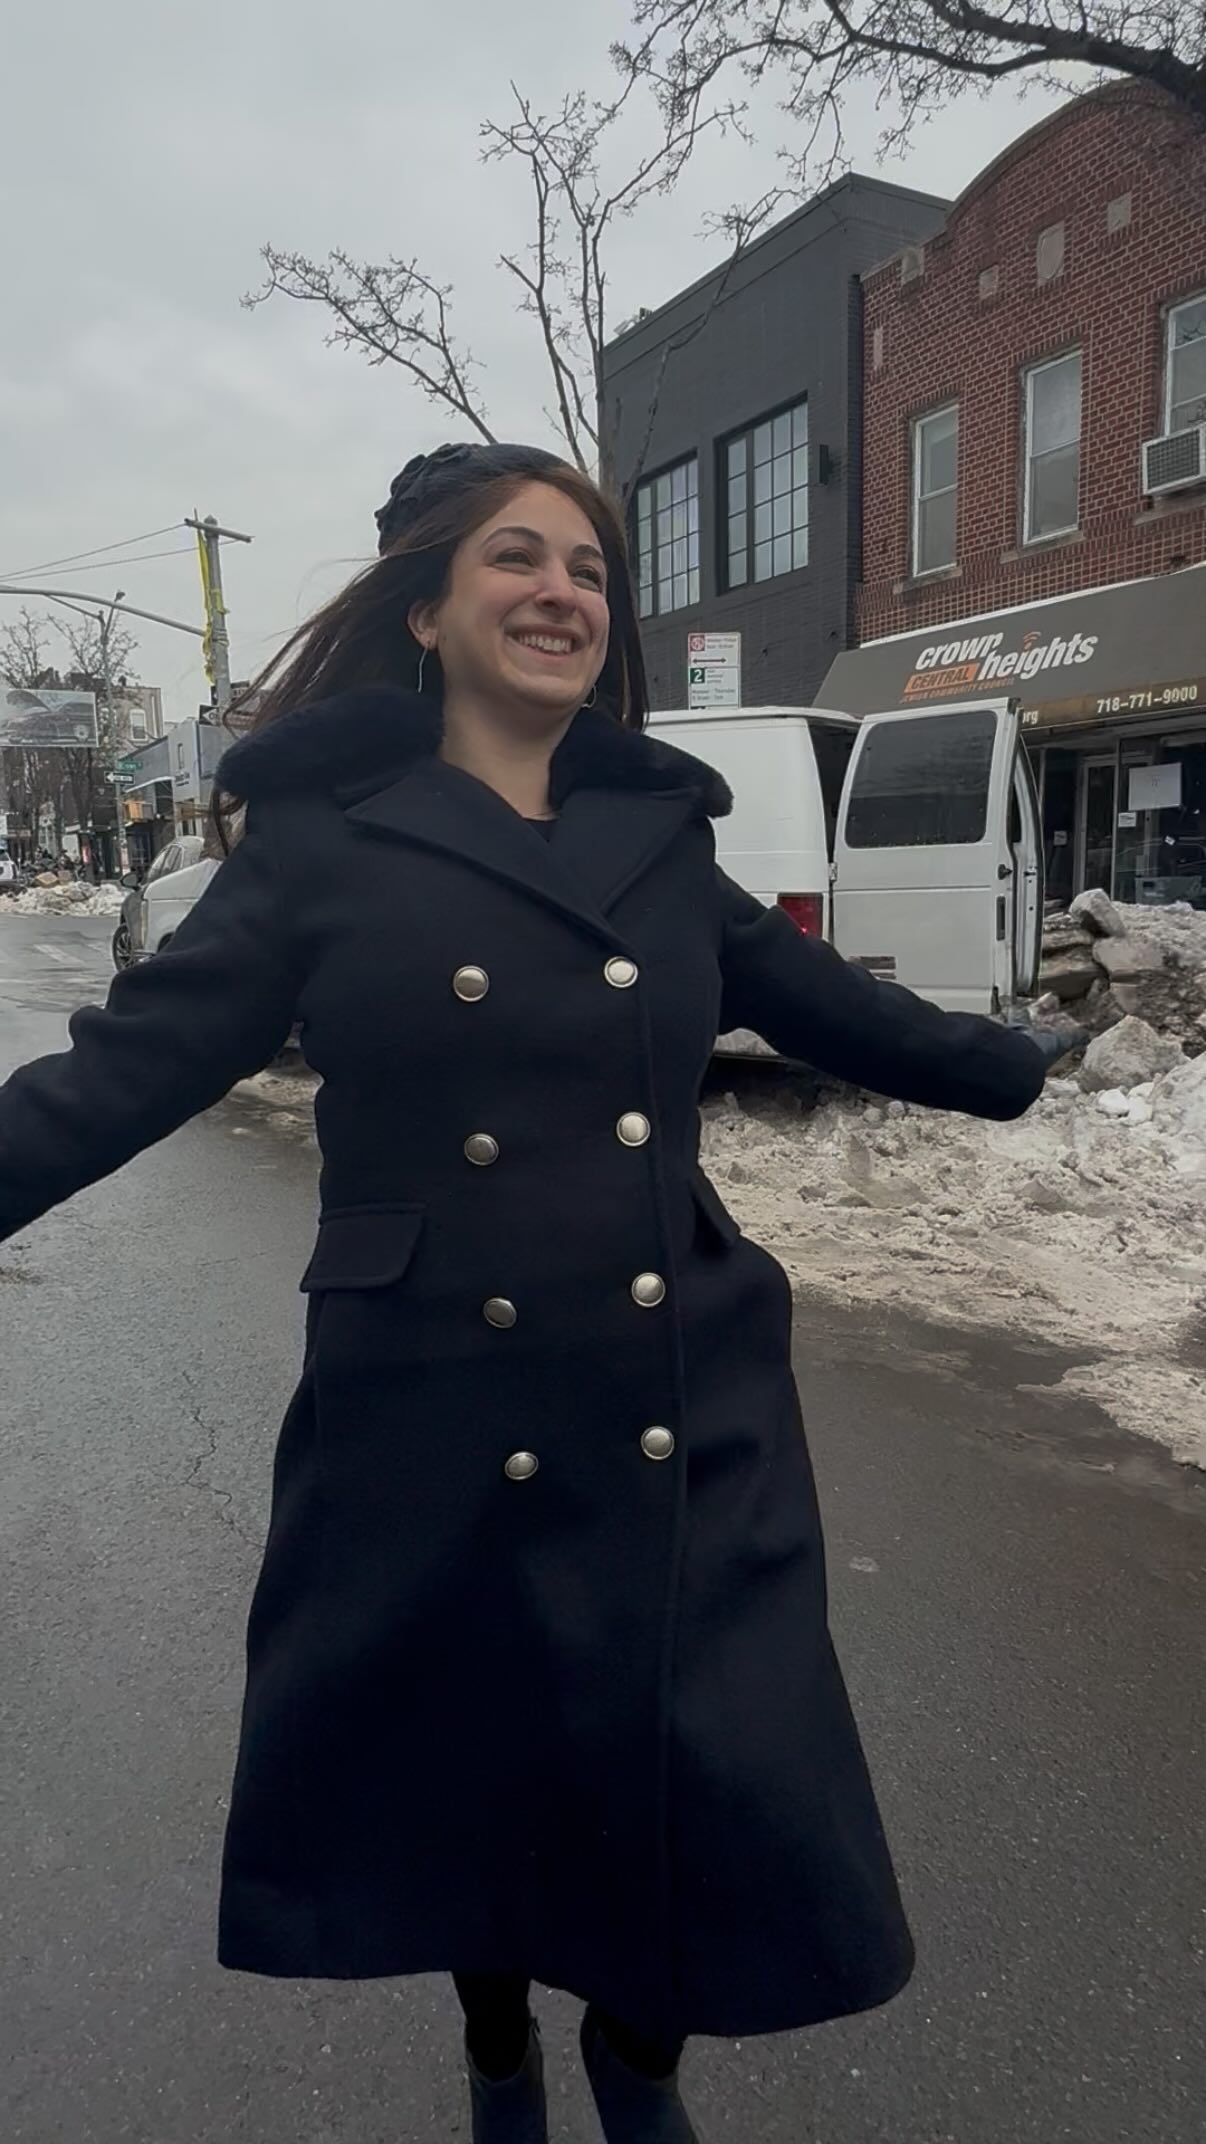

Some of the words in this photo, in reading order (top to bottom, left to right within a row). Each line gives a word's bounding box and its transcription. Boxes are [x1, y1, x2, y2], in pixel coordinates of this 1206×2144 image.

[915, 632, 1004, 671] crown
[977, 632, 1099, 681] heights
[694, 669, 703, 682] 2
[911, 666, 969, 689] CENTRAL
[1096, 685, 1198, 714] 718-771-9000
